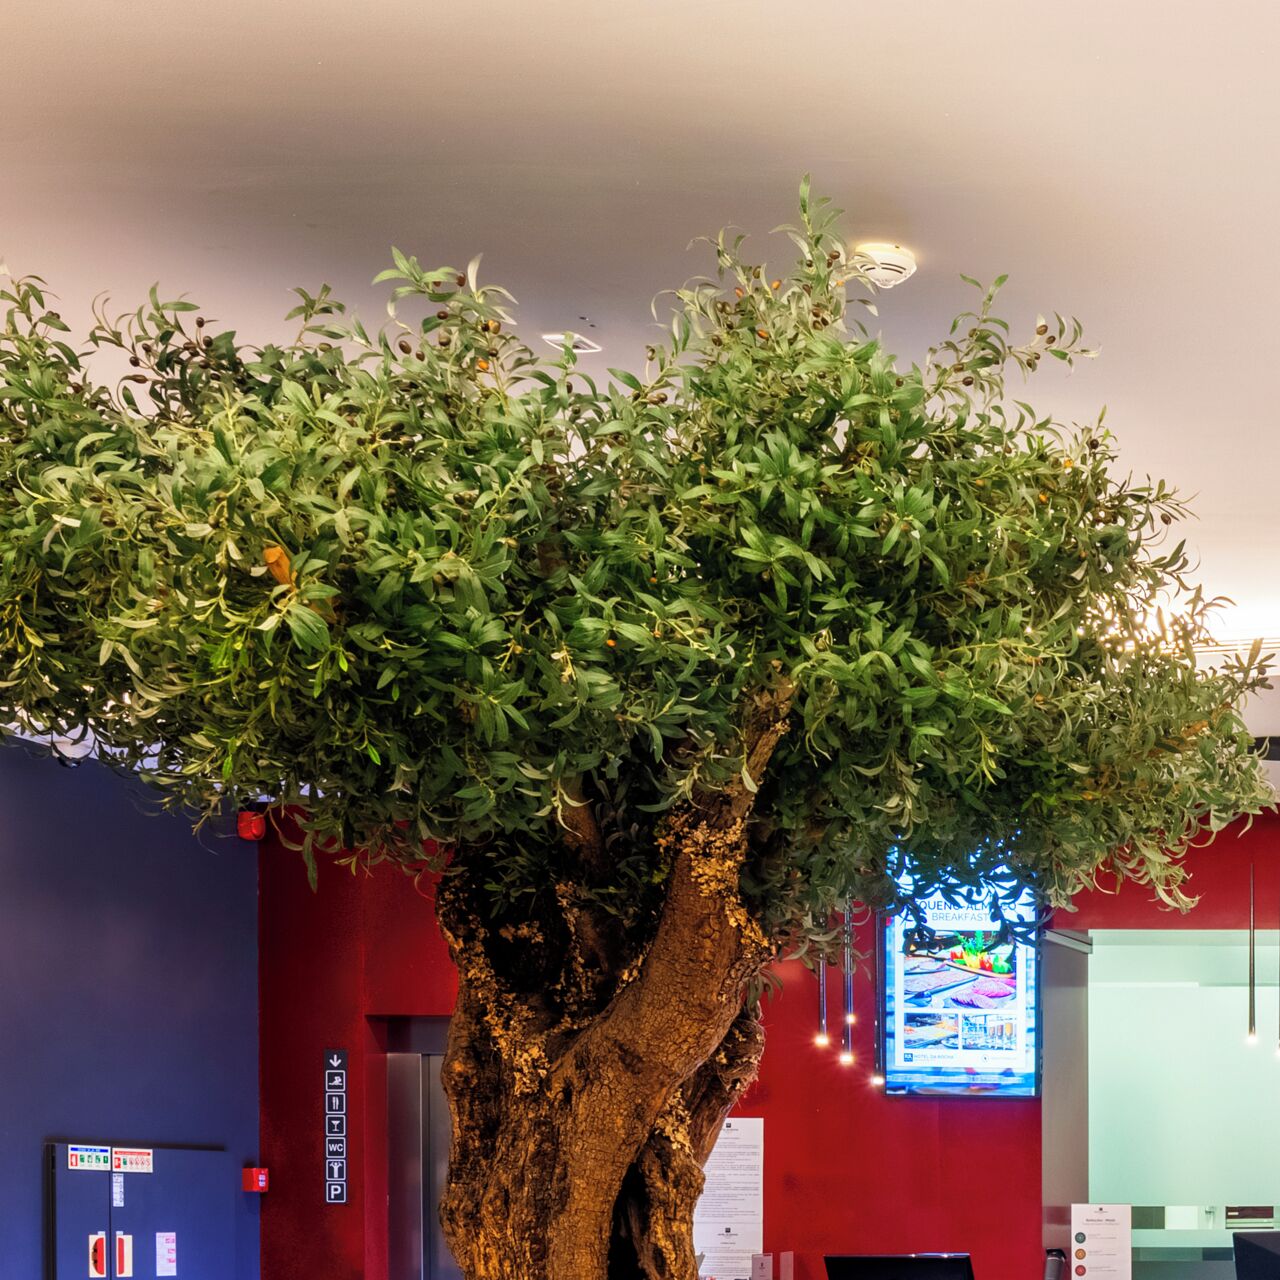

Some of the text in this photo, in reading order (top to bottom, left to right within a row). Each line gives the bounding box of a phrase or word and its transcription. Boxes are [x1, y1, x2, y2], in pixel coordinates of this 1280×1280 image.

[931, 912, 989, 921] BREAKFAST
[329, 1143, 343, 1151] WC
[331, 1185, 341, 1199] P
